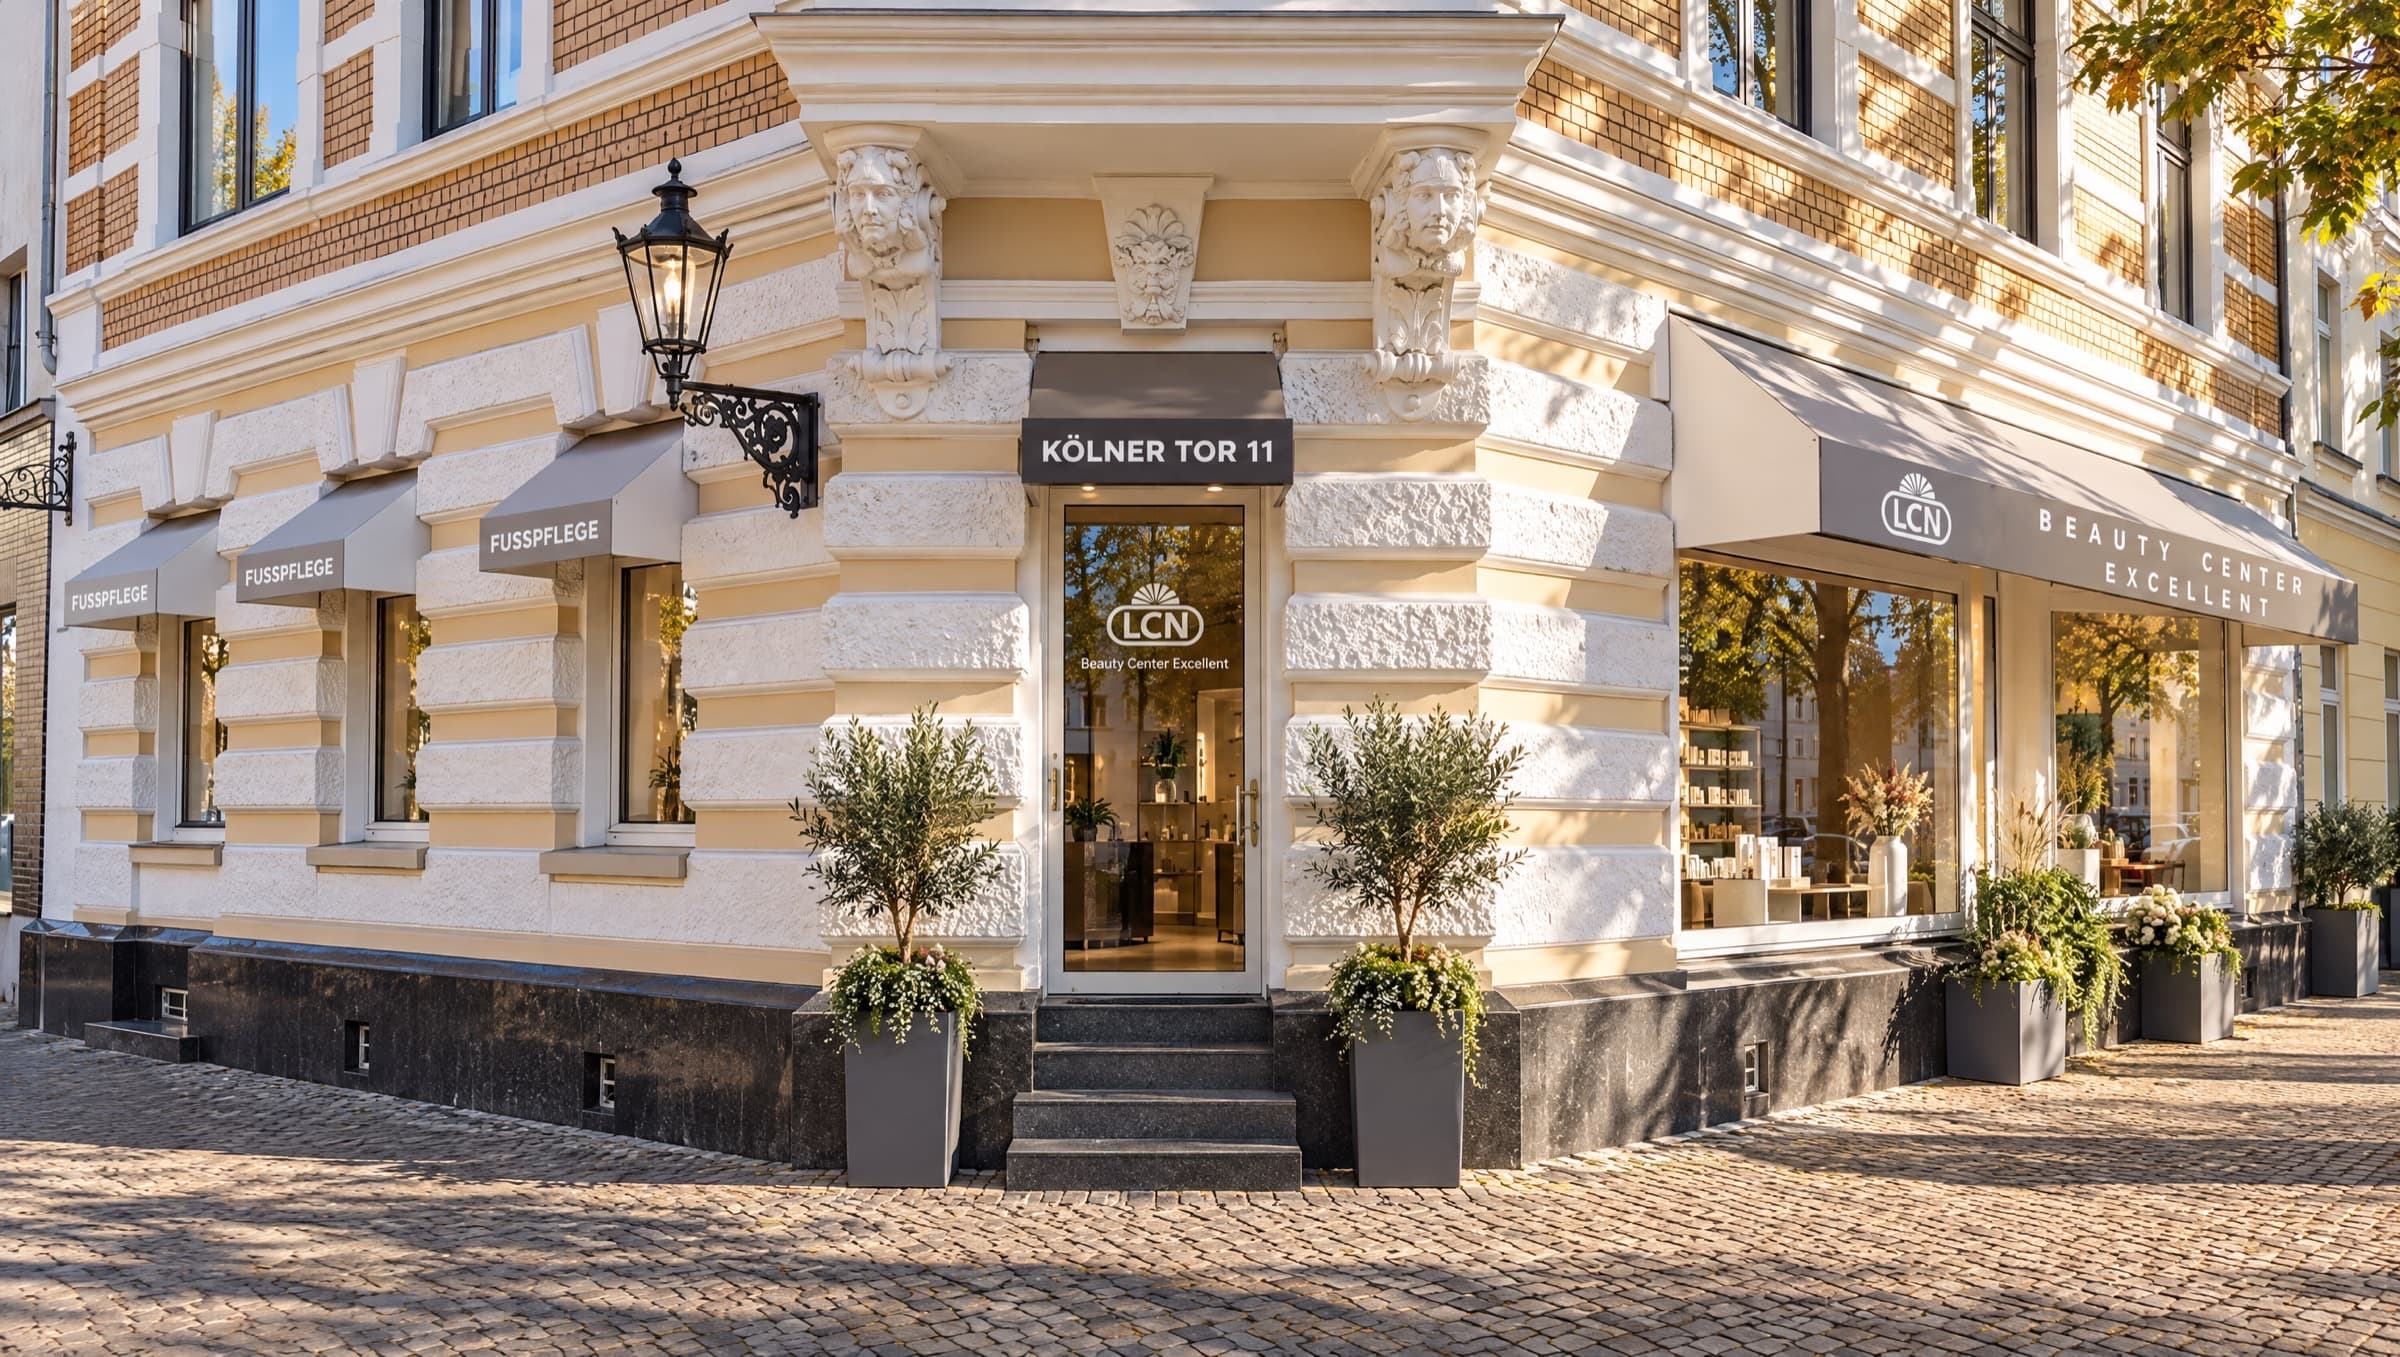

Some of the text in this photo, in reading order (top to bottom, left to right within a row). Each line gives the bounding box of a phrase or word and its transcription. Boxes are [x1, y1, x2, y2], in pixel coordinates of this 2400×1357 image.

[1042, 434, 1272, 462] KÖLNER TOR 11
[1894, 499, 1941, 537] LCN
[491, 519, 598, 553] FUSSPFLEGE
[2040, 509, 2303, 596] BEAUTY CENTER
[244, 557, 333, 586] FUSSPFLEGE
[71, 584, 148, 611] FUSSPFLEGE
[2106, 562, 2269, 617] EXCELLENT
[1123, 612, 1188, 639] LCN
[1081, 656, 1229, 672] Beauty Center Excellent
